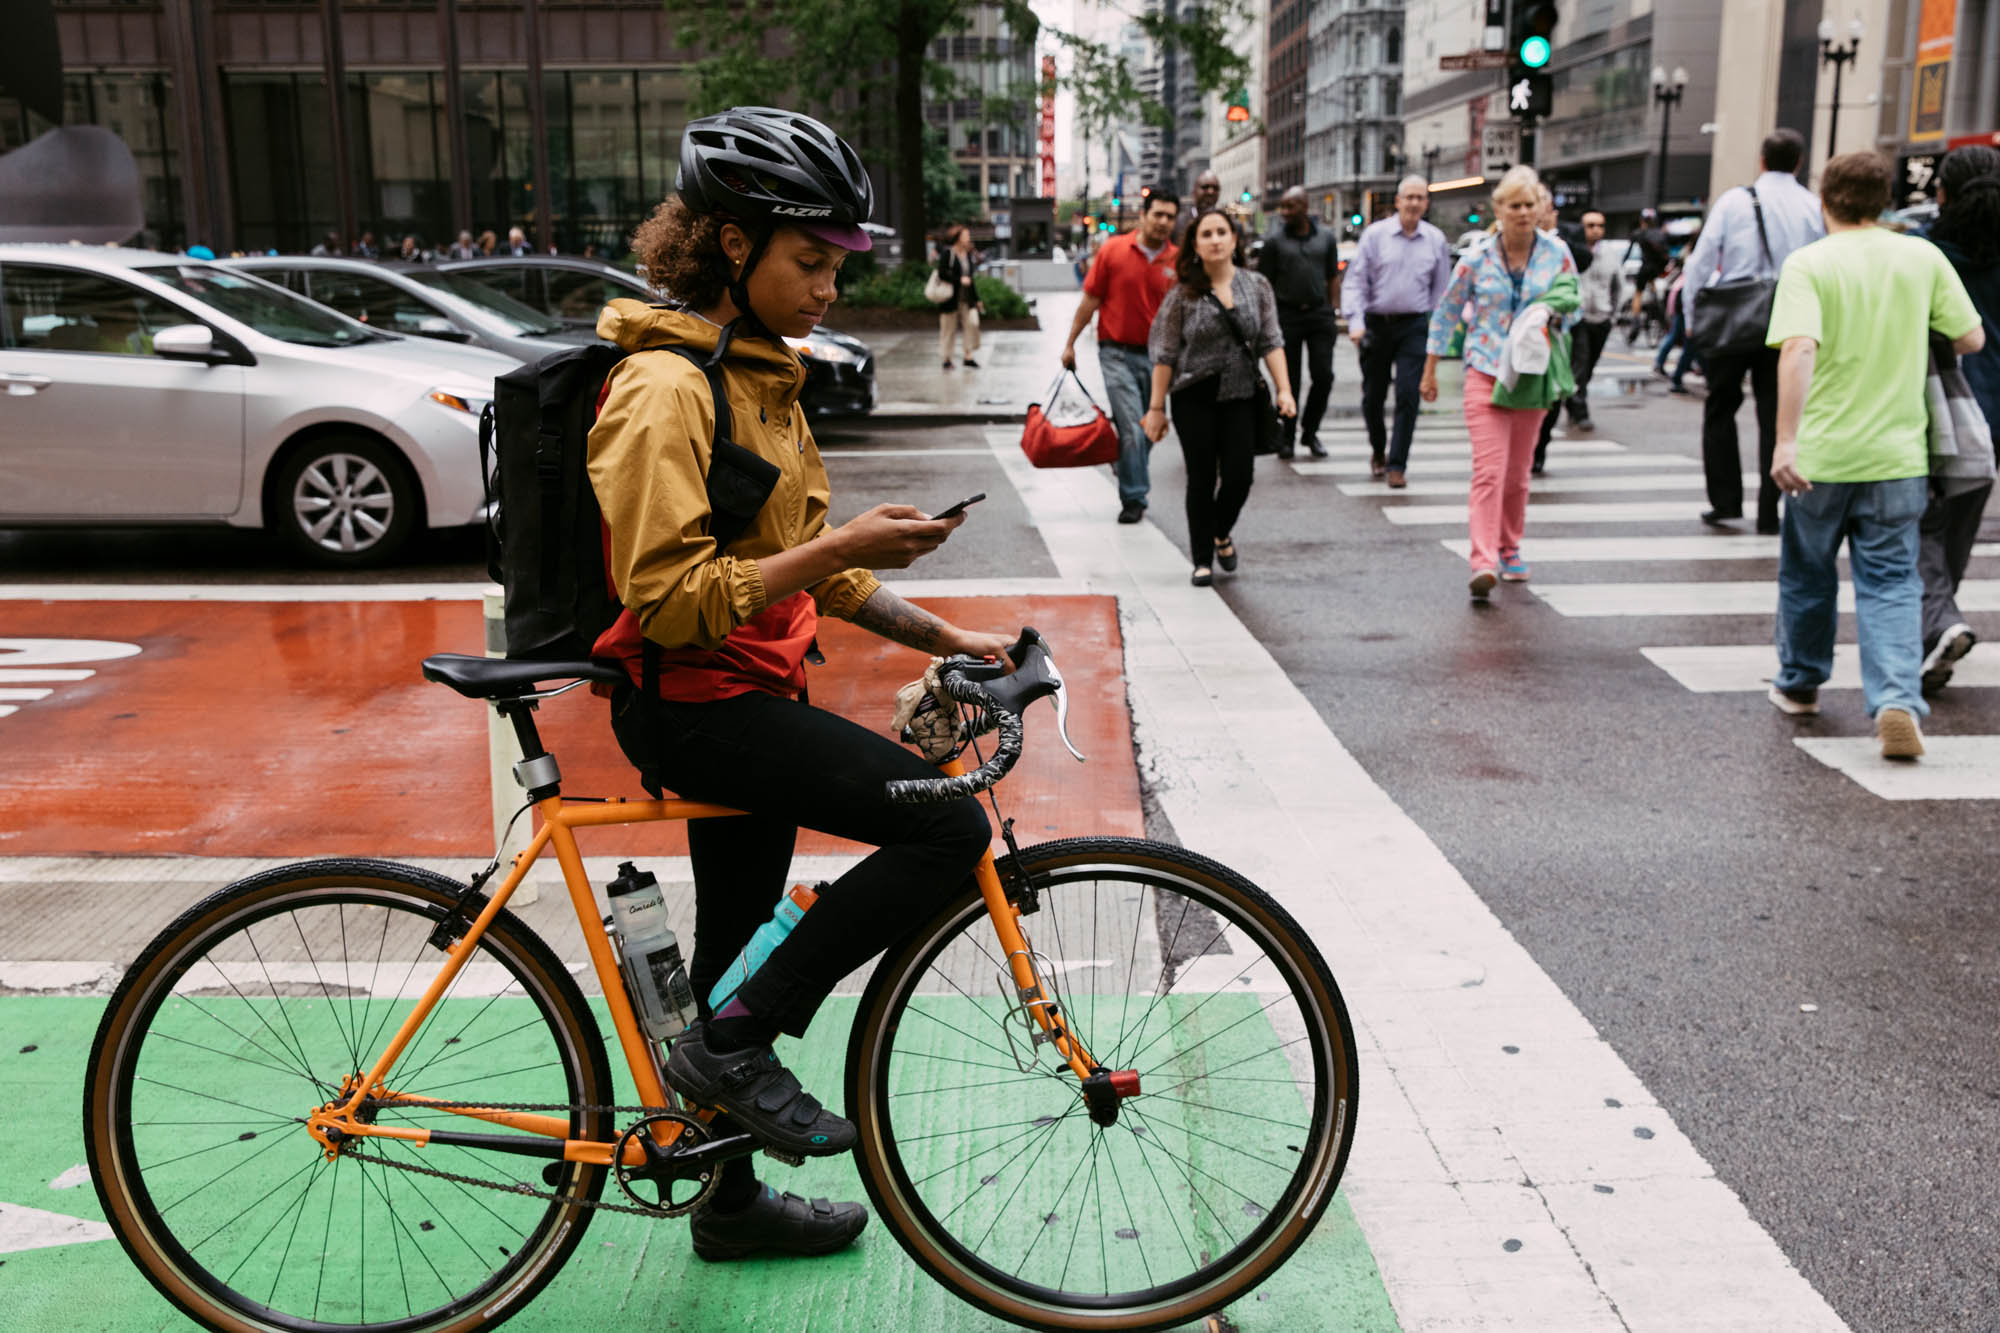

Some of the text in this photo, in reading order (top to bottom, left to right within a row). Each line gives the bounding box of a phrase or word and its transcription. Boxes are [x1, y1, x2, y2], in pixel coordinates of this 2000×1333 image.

[1488, 130, 1514, 142] ONE
[1487, 145, 1514, 157] WAY
[772, 206, 832, 217] LAZER
